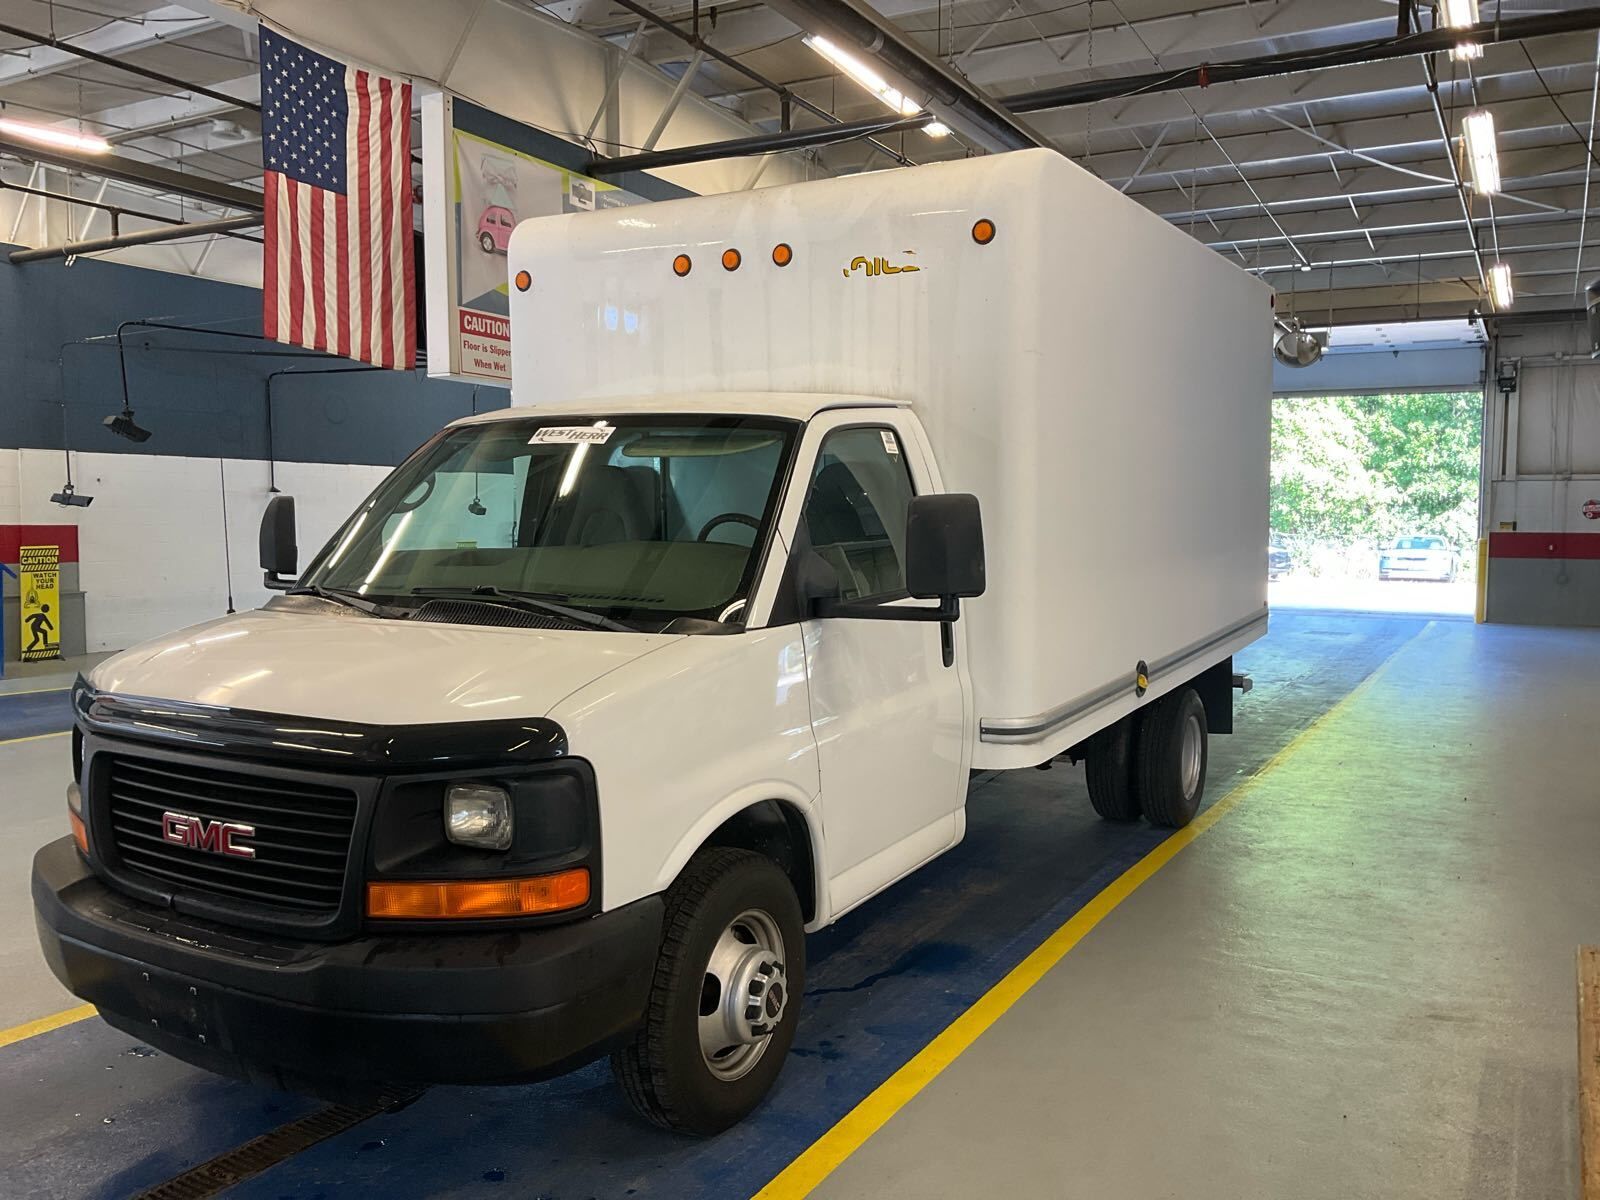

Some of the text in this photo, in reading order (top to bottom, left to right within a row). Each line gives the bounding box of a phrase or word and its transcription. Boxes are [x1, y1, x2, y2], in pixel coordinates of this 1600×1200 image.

[464, 315, 510, 337] CAUTION
[463, 340, 512, 357] Floor is Slipper
[474, 359, 506, 372] When Wet
[535, 429, 609, 440] WEST HERR
[21, 556, 58, 564] CAUTION
[162, 811, 255, 858] GMC
